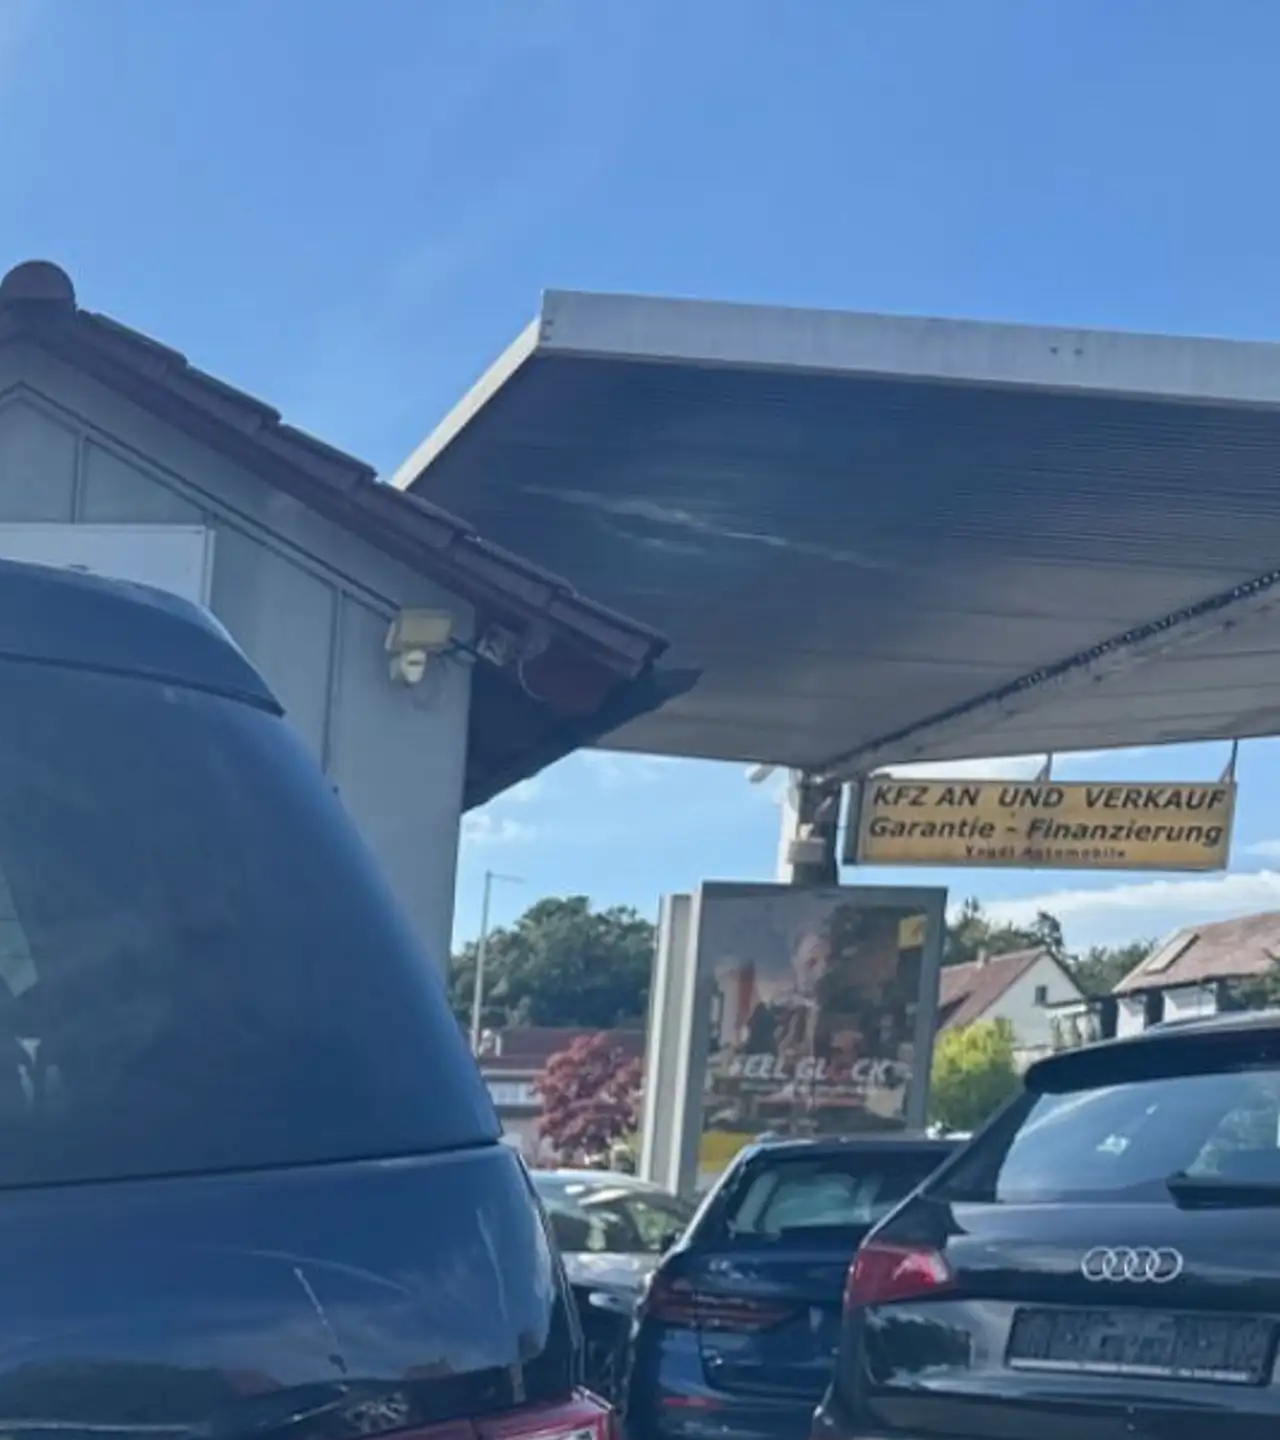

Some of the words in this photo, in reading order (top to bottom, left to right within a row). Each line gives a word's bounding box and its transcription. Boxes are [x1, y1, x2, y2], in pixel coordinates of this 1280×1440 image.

[873, 785, 929, 807] KFZ
[935, 786, 981, 807] AN
[997, 787, 1065, 808] UND
[1085, 787, 1228, 810] VERKAUF
[869, 816, 996, 839] Garantie
[1027, 816, 1224, 848] Finanzierung
